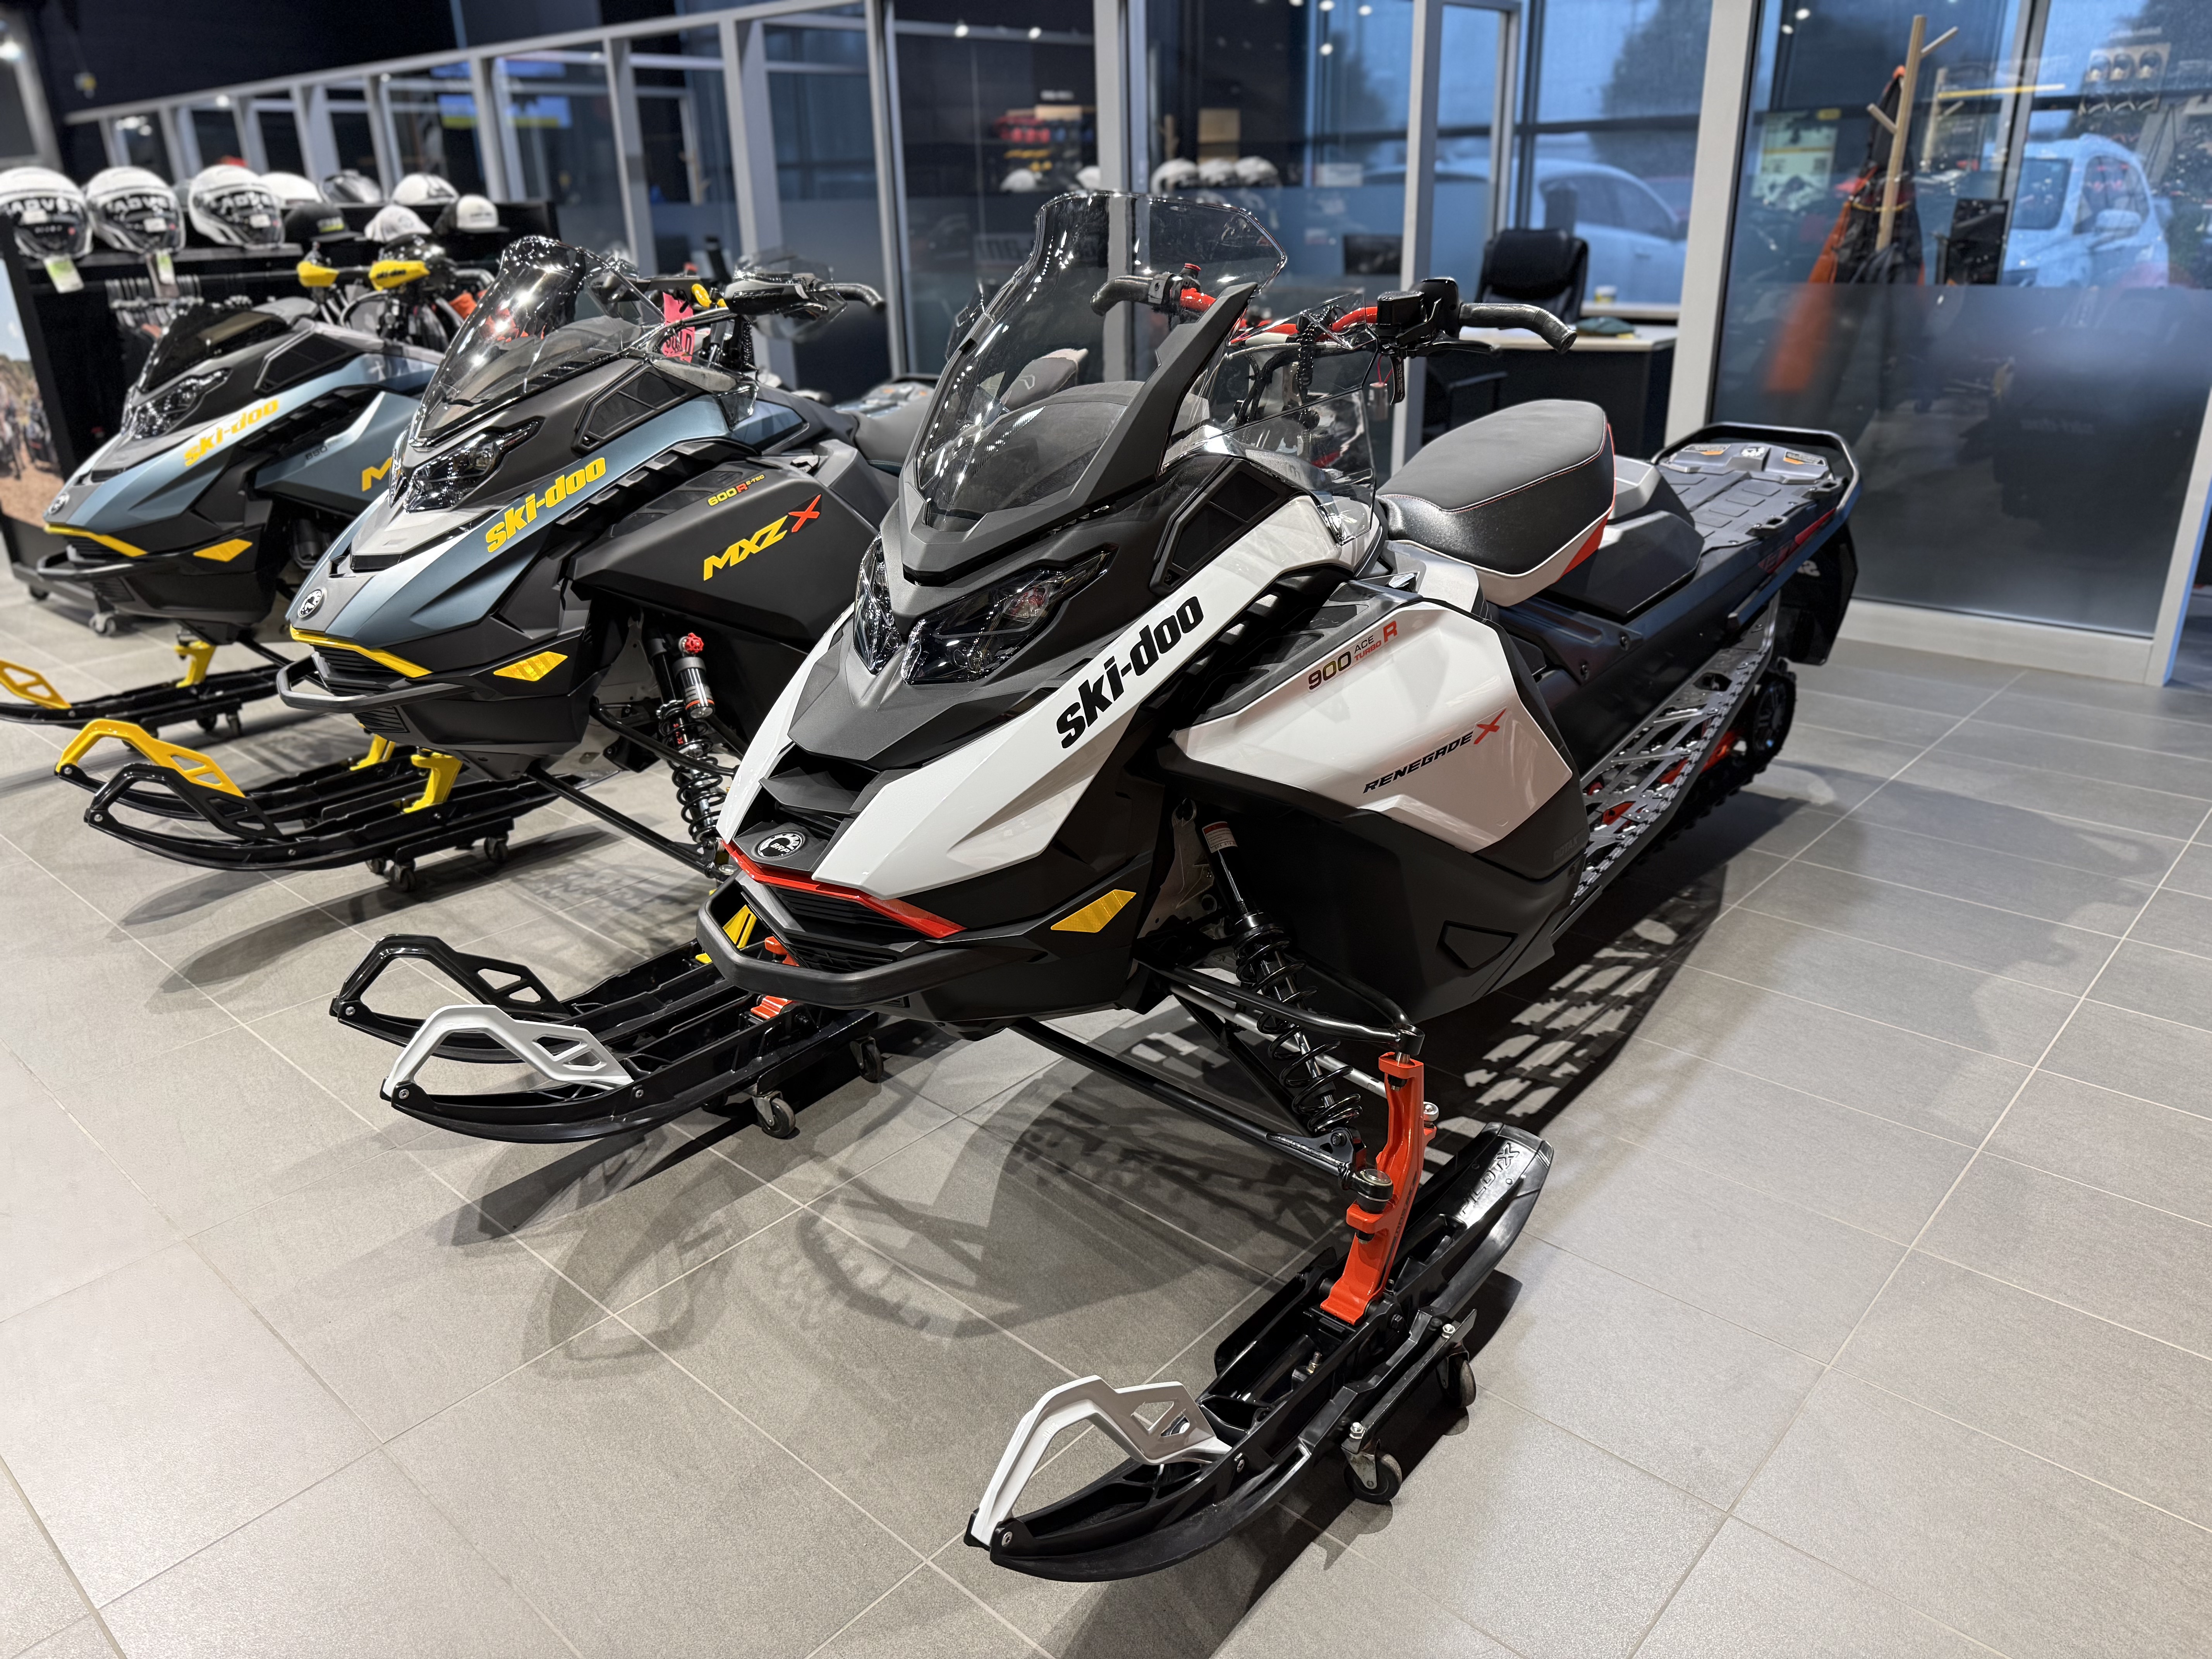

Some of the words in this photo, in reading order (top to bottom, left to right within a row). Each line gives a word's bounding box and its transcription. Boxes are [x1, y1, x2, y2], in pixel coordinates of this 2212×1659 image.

[184, 399, 279, 467] ski-doo
[486, 457, 606, 553] ski-doo
[1354, 640, 1382, 661] TURBO
[1355, 635, 1374, 654] ACE
[1383, 620, 1398, 643] R
[1056, 596, 1204, 749] ski-doo
[1308, 651, 1352, 690] 900
[1363, 731, 1473, 793] RENEGADE
[1474, 708, 1506, 744] X
[770, 842, 790, 853] BRP
